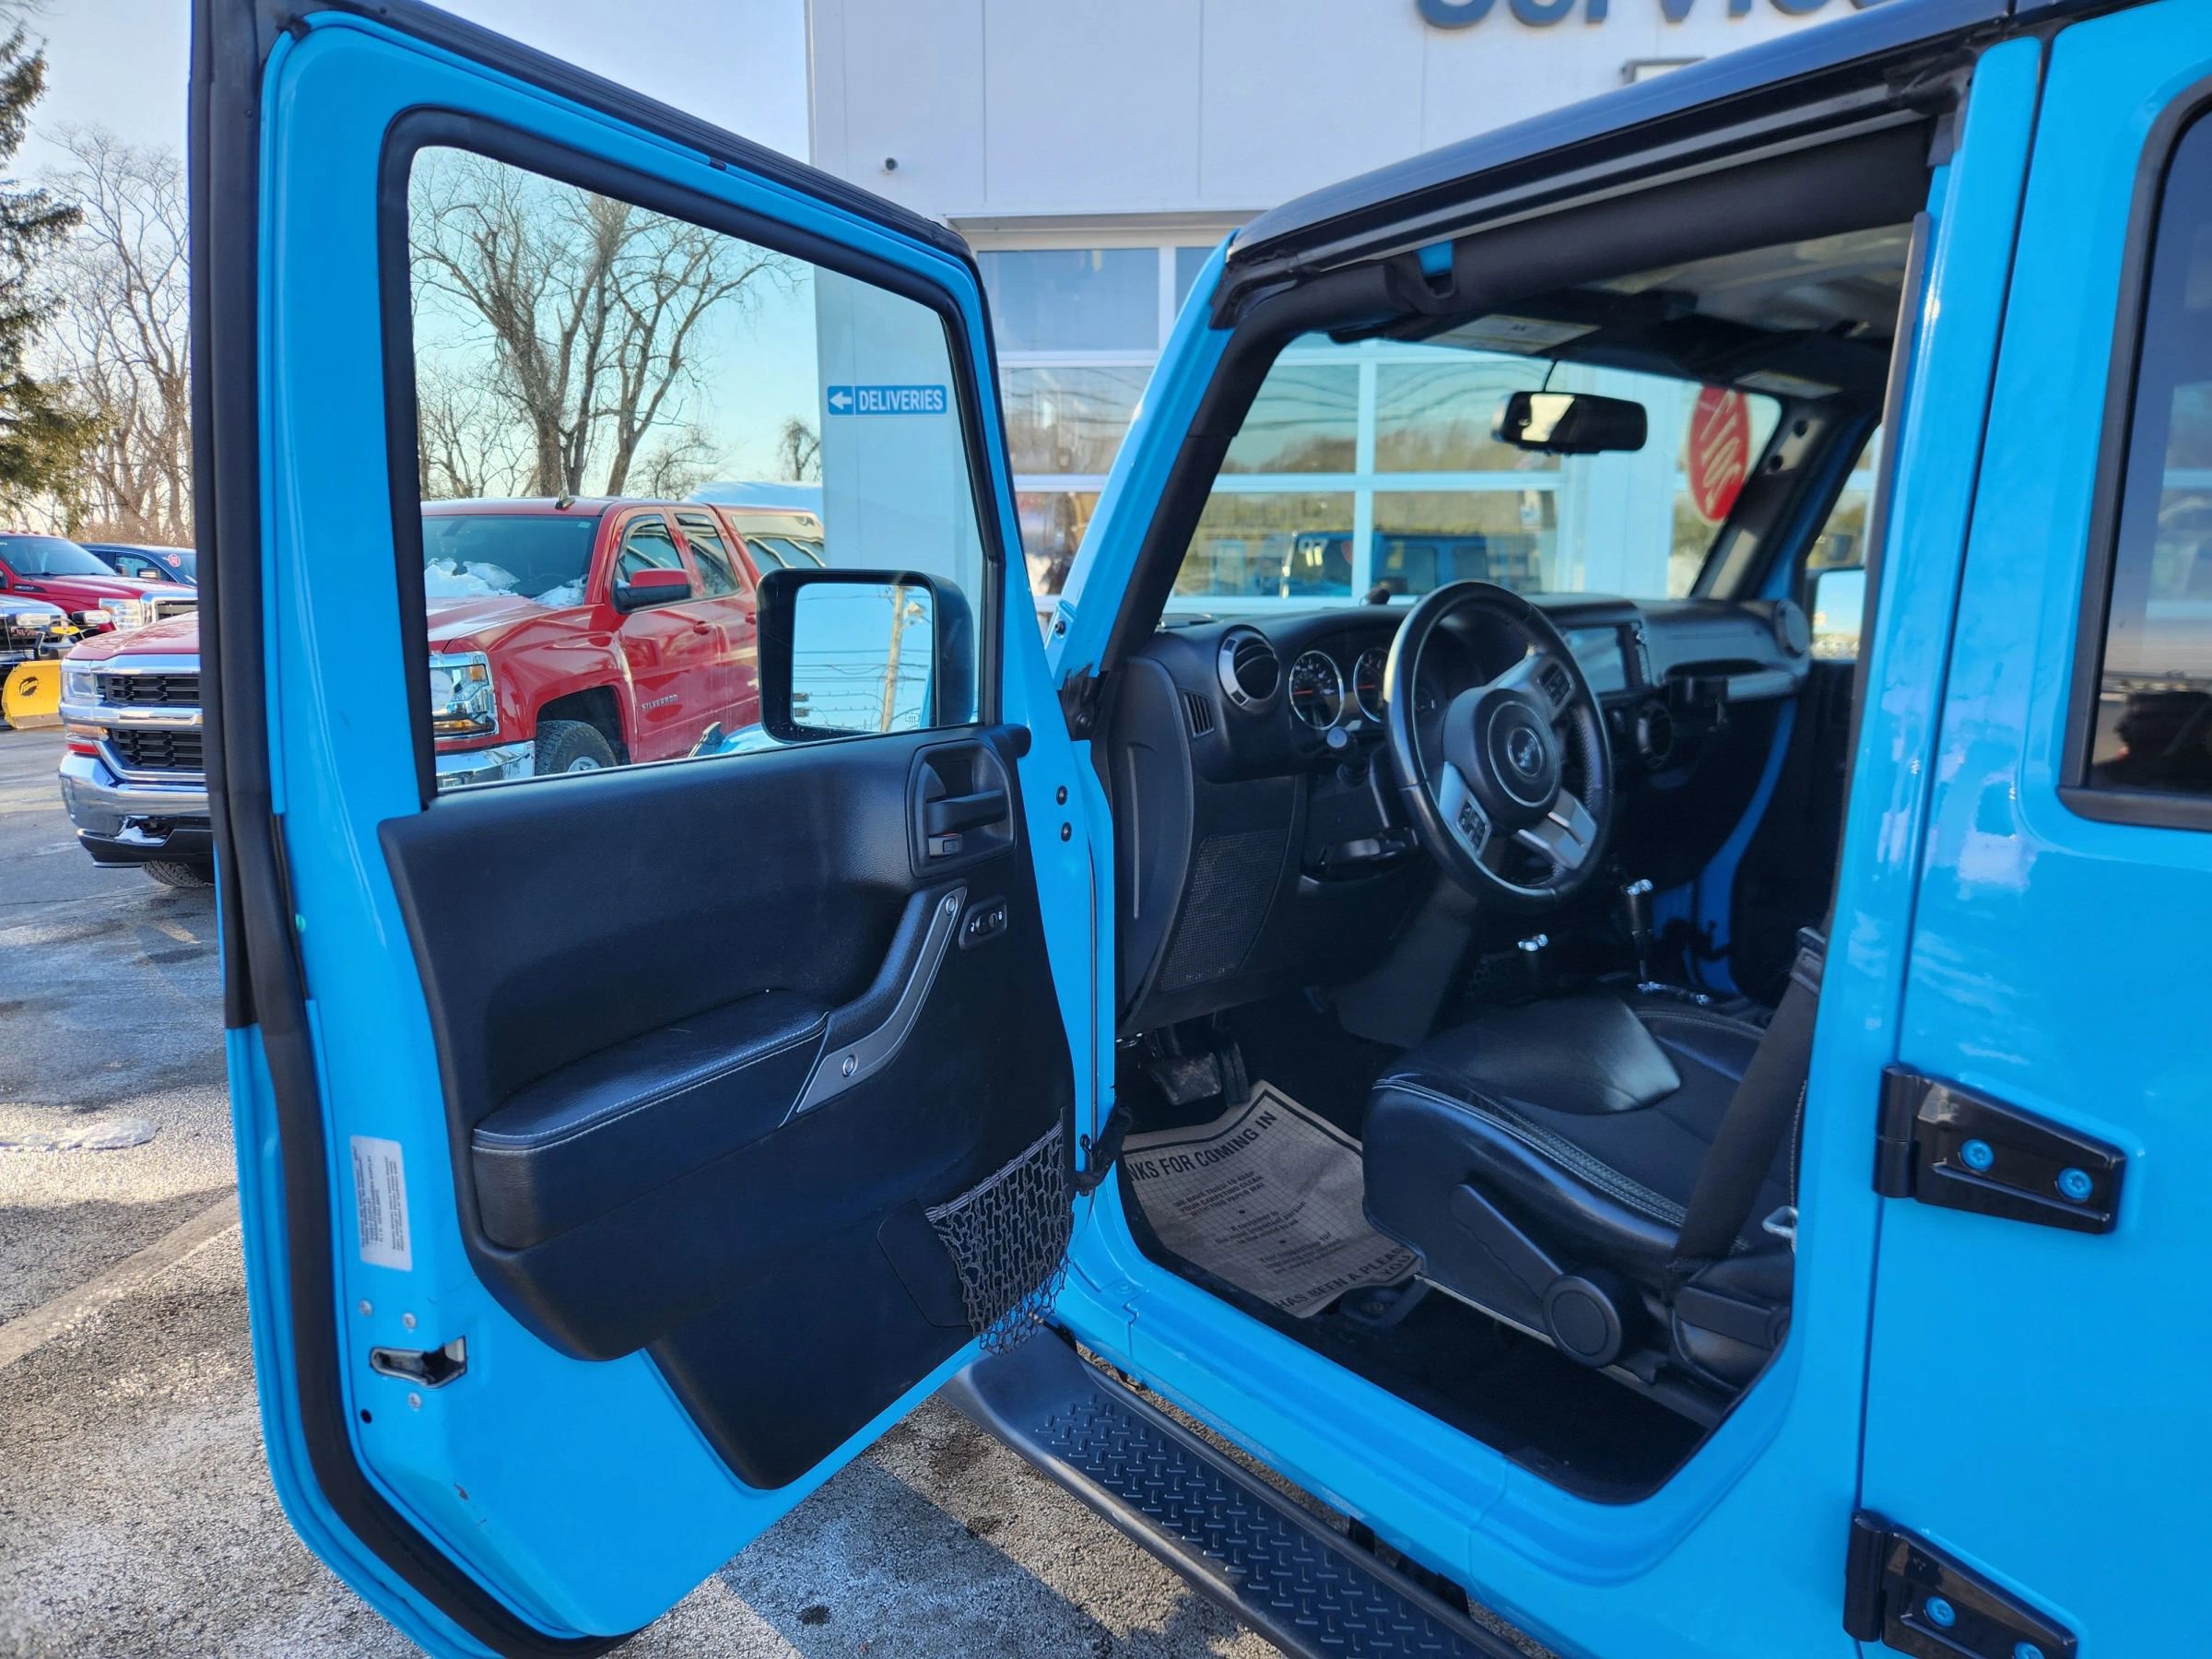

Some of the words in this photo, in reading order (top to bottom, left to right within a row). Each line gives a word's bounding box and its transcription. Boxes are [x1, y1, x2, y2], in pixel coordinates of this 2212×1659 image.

[859, 389, 944, 411] DELIVERIES
[1159, 1154, 1197, 1176] FOR
[1194, 1127, 1260, 1168] COMING
[1254, 1110, 1278, 1130] IN
[1275, 1293, 1310, 1310] HAS
[1307, 1277, 1348, 1298] BEEN
[1347, 1271, 1361, 1282] A
